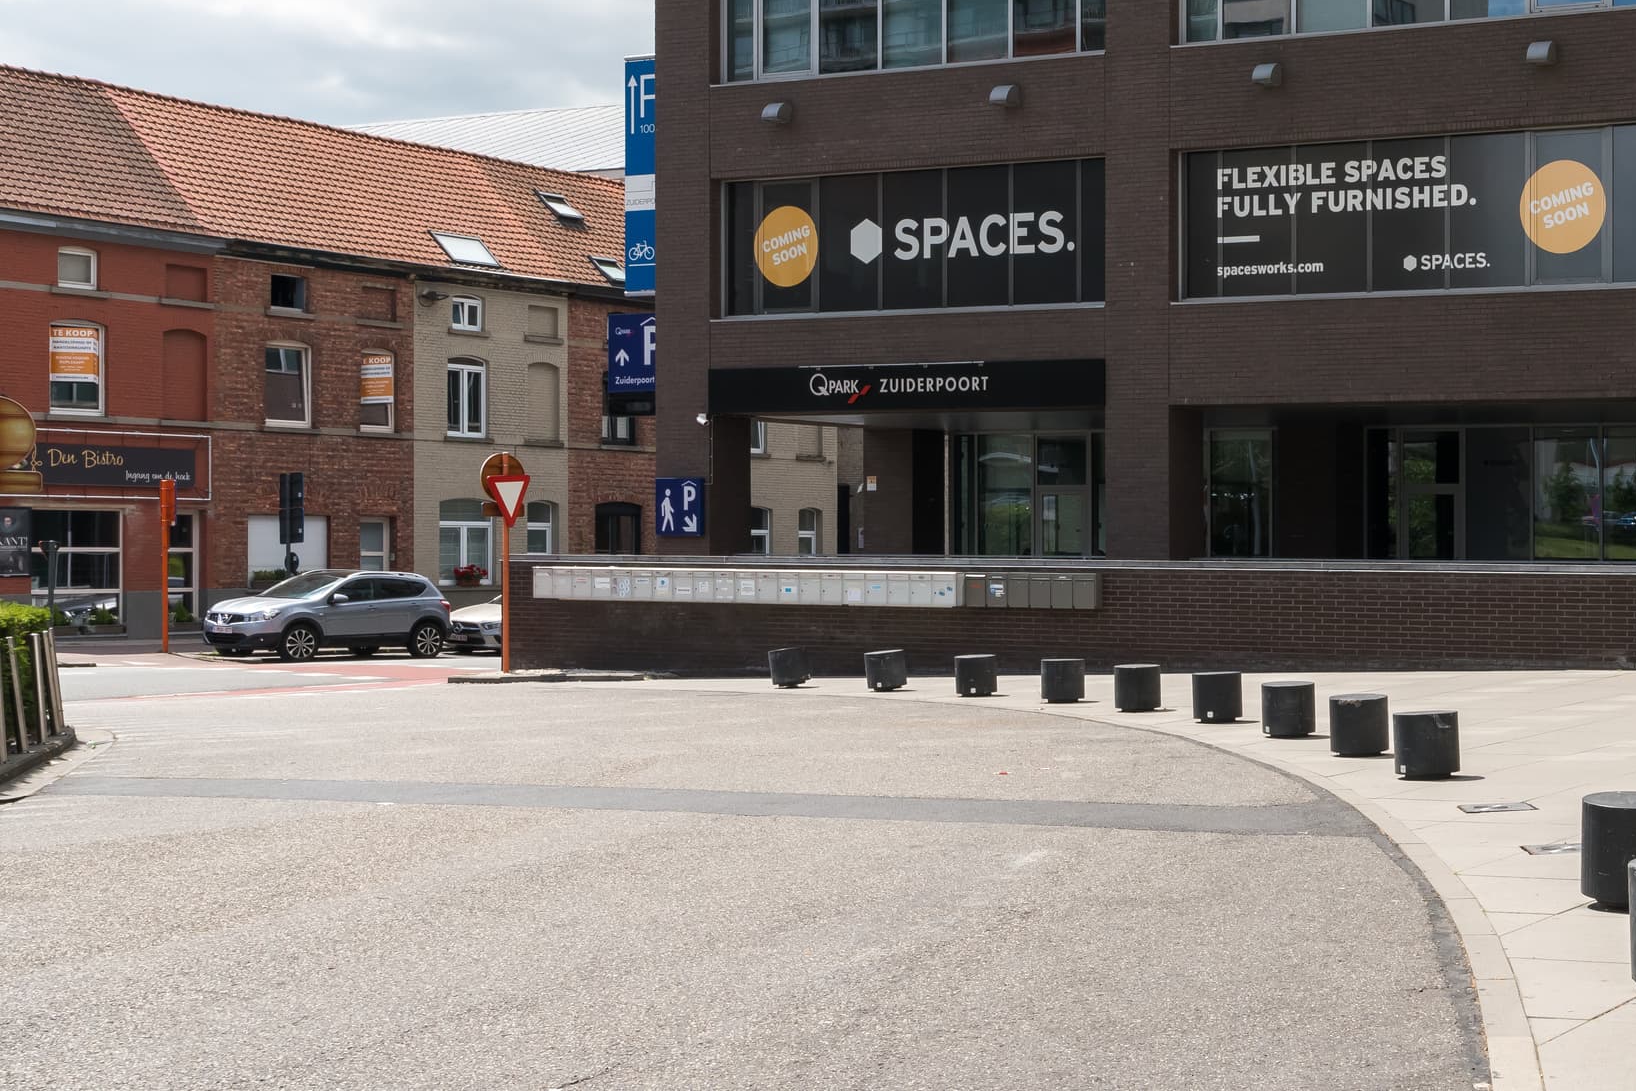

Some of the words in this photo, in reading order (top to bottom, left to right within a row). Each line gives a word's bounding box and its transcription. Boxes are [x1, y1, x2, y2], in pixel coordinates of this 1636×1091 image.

[1217, 162, 1336, 189] FLEXIBLE
[1344, 156, 1447, 183] SPACES
[1217, 193, 1302, 218] FULLY
[1311, 184, 1477, 213] FURNISHED.
[1530, 181, 1594, 215] COMING
[1543, 202, 1589, 228] SOON
[762, 224, 811, 253] COMING
[894, 211, 1075, 261] SPACES.
[772, 244, 808, 266] SOON
[1420, 253, 1491, 270] SPACES.
[1217, 261, 1324, 278] spacesworks.com
[65, 329, 93, 337] KOOP
[615, 375, 655, 386] Zuiderpoort
[809, 373, 859, 396] QPARK
[879, 376, 989, 393] ZUIDERPOORT
[48, 448, 77, 467] Den
[82, 449, 124, 469] Bistro
[683, 485, 696, 511] P
